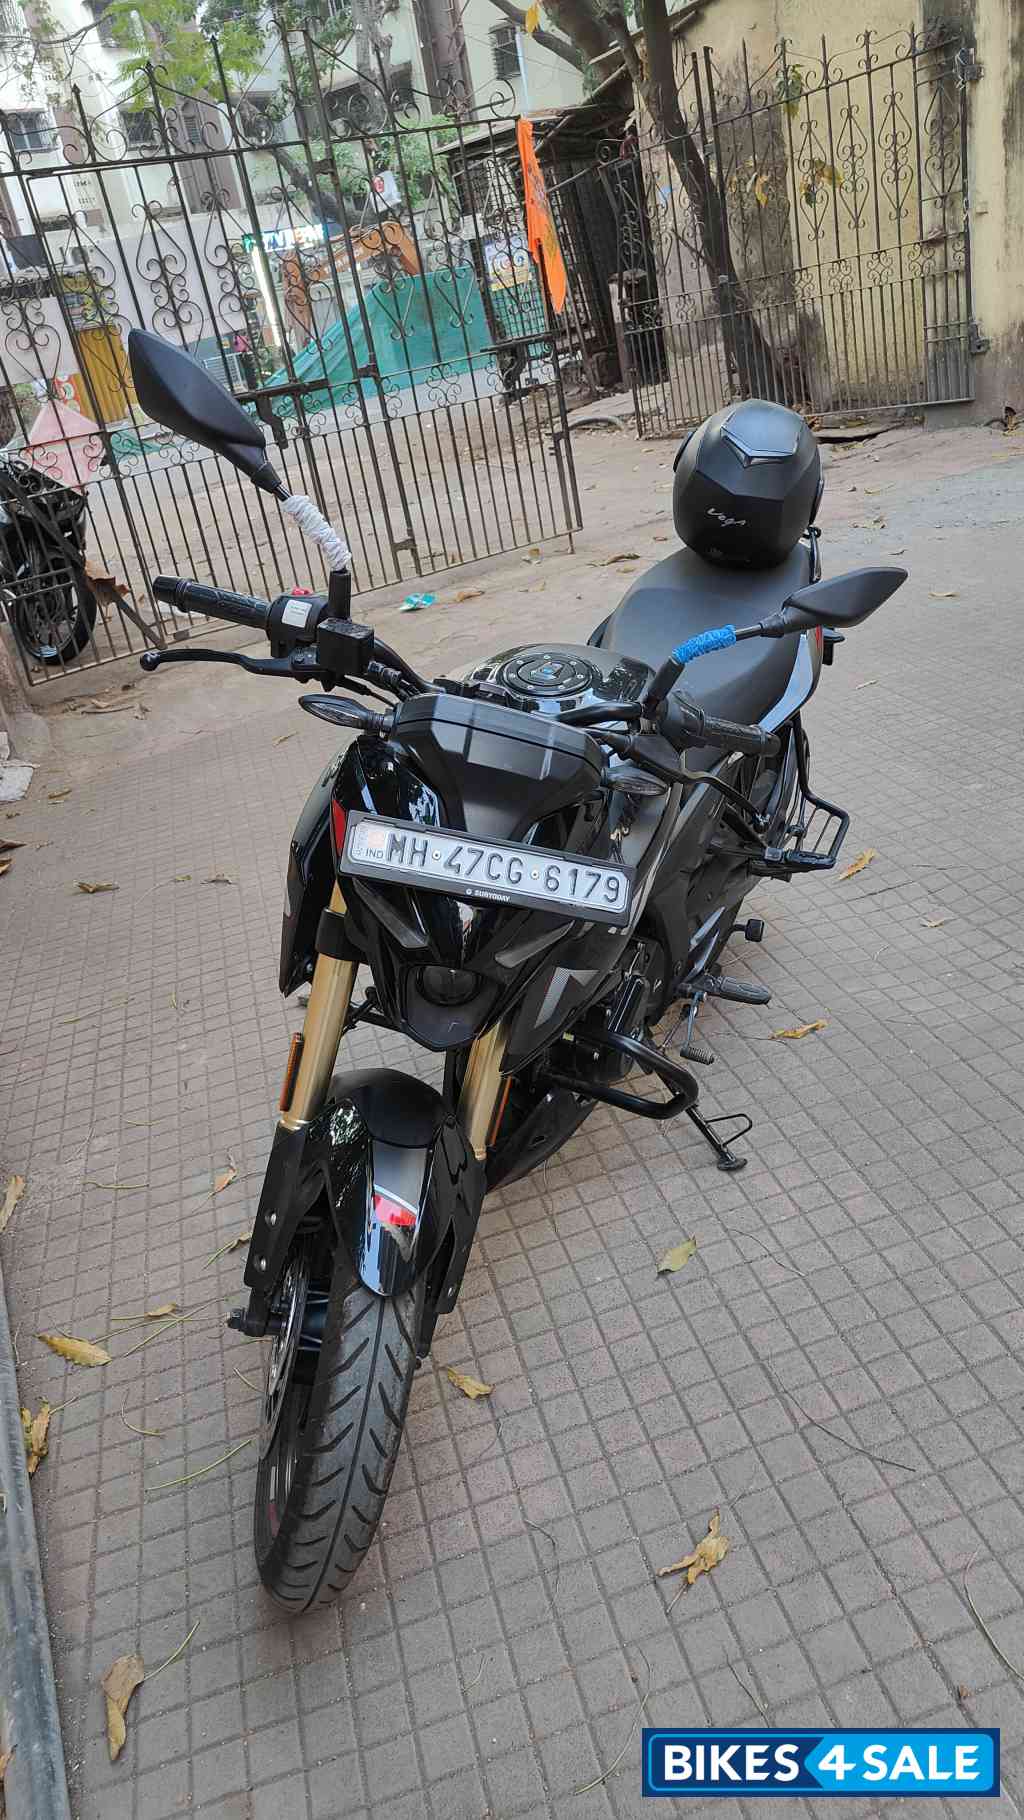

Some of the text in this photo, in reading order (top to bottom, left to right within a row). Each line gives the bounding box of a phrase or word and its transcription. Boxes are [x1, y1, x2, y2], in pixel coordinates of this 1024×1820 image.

[365, 847, 384, 859] IND
[385, 831, 428, 867] MH
[442, 845, 524, 884] 47CG
[544, 864, 620, 903] 6179
